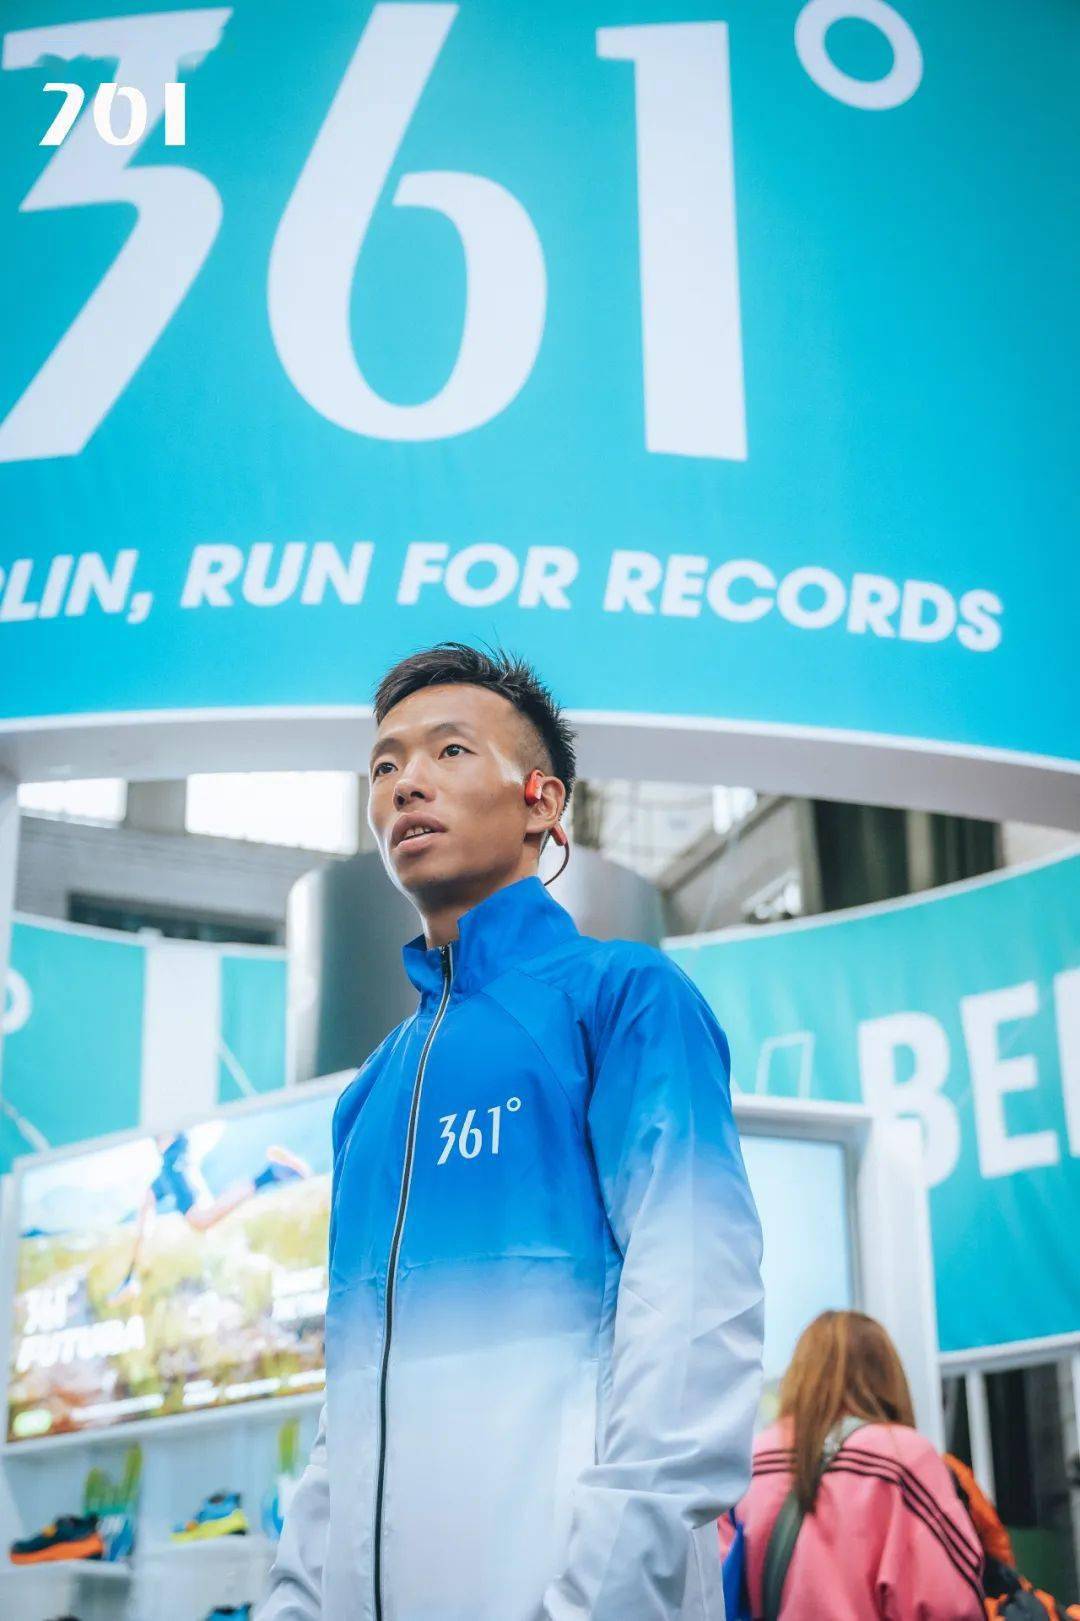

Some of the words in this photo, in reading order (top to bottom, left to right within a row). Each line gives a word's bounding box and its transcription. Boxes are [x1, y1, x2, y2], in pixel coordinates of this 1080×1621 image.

[0, 548, 153, 624] LIN,
[180, 541, 375, 607] RUN
[396, 541, 580, 610] FOR
[602, 549, 1005, 652] RECORDS
[437, 1096, 522, 1166] 361°
